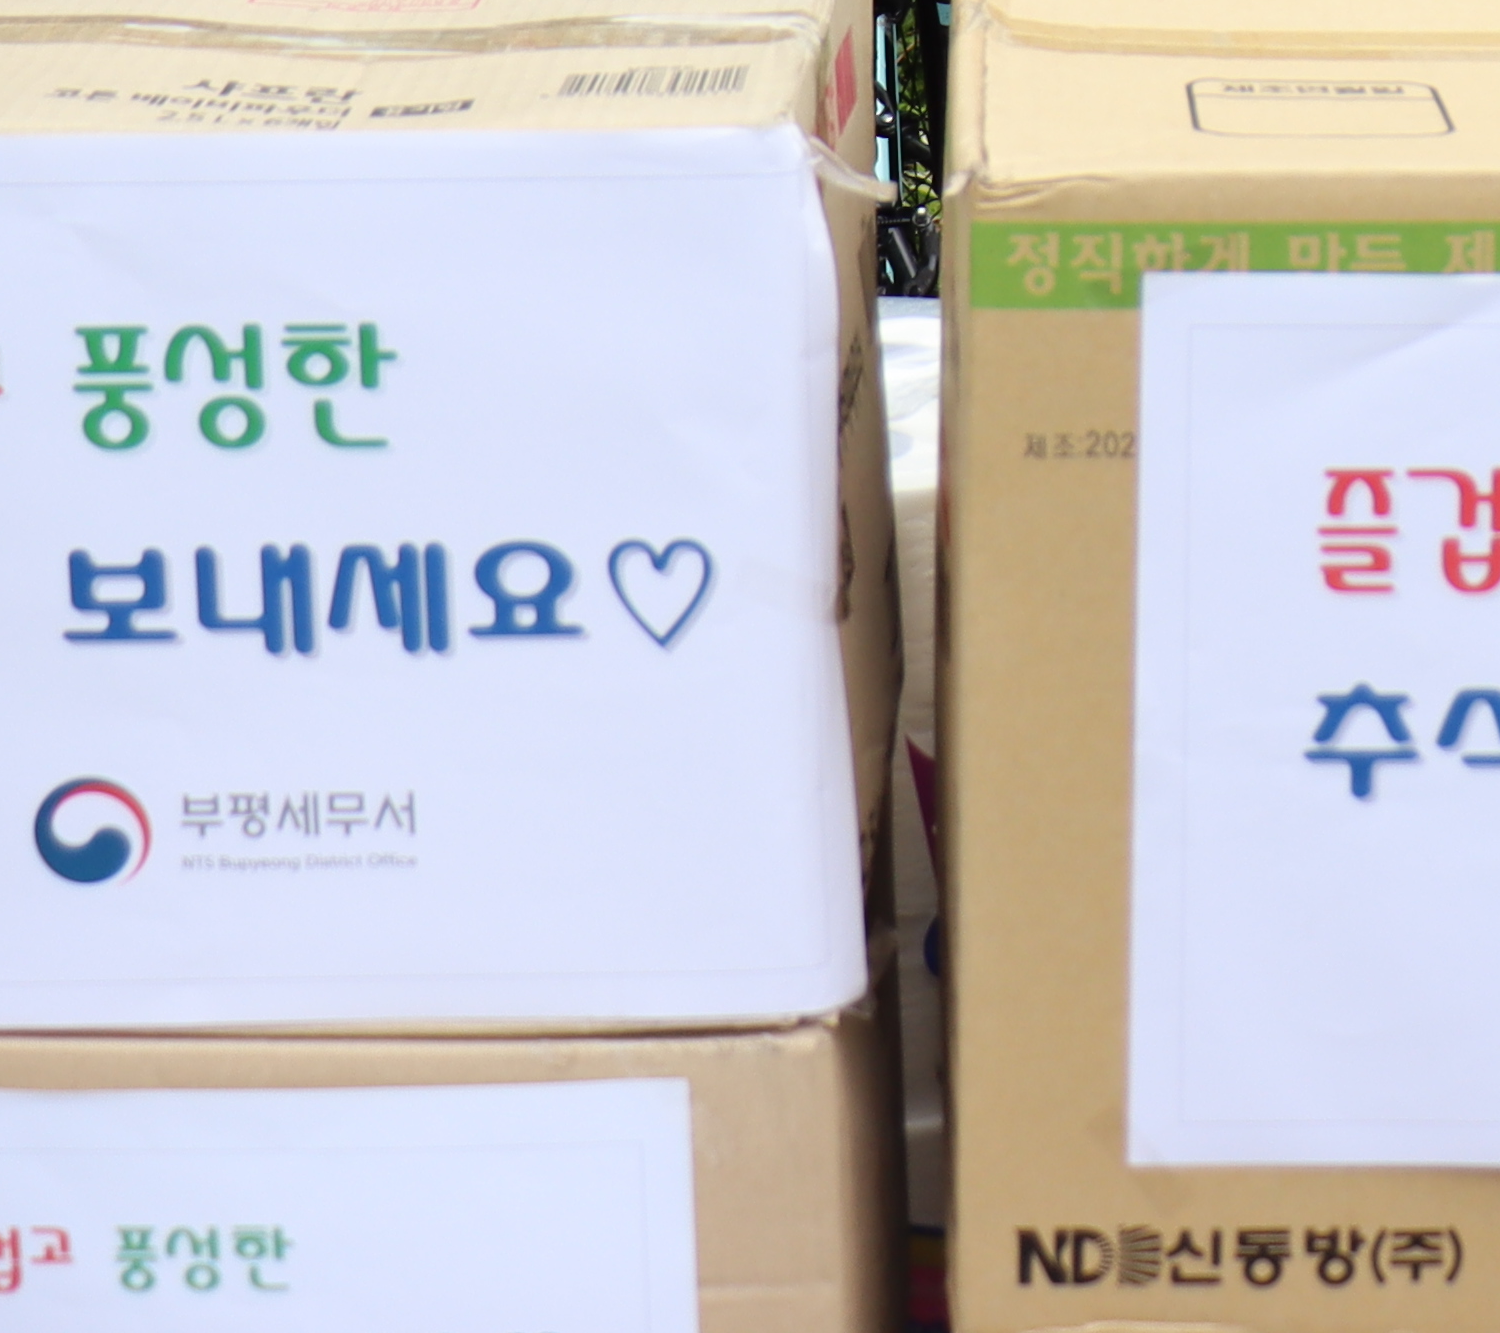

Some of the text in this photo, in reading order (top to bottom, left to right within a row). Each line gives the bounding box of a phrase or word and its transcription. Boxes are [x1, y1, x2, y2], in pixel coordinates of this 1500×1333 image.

[183, 79, 361, 104] 샤프란
[74, 324, 396, 451] 풍성한
[63, 541, 583, 657] 보내세요
[181, 791, 417, 838] 부평세무서
[116, 1225, 290, 1292] 풍성한
[1166, 1227, 1464, 1289] 신동방(주)
